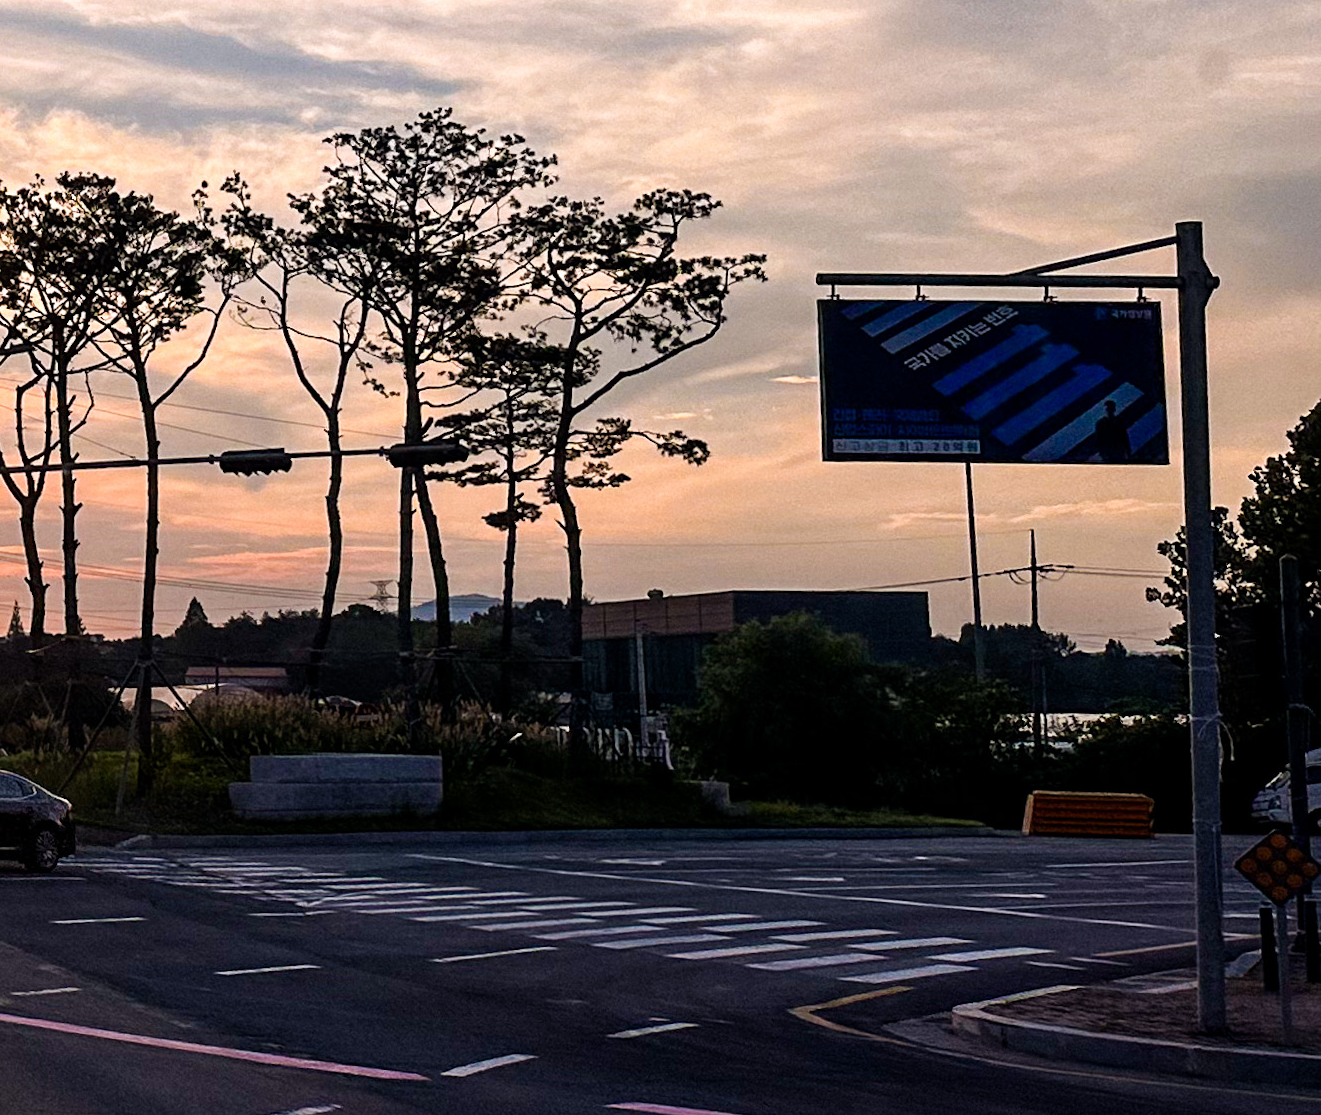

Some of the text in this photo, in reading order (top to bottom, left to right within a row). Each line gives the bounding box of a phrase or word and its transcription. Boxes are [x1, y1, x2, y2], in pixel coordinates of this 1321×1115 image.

[903, 303, 1020, 372] 국가를 지키는 번호
